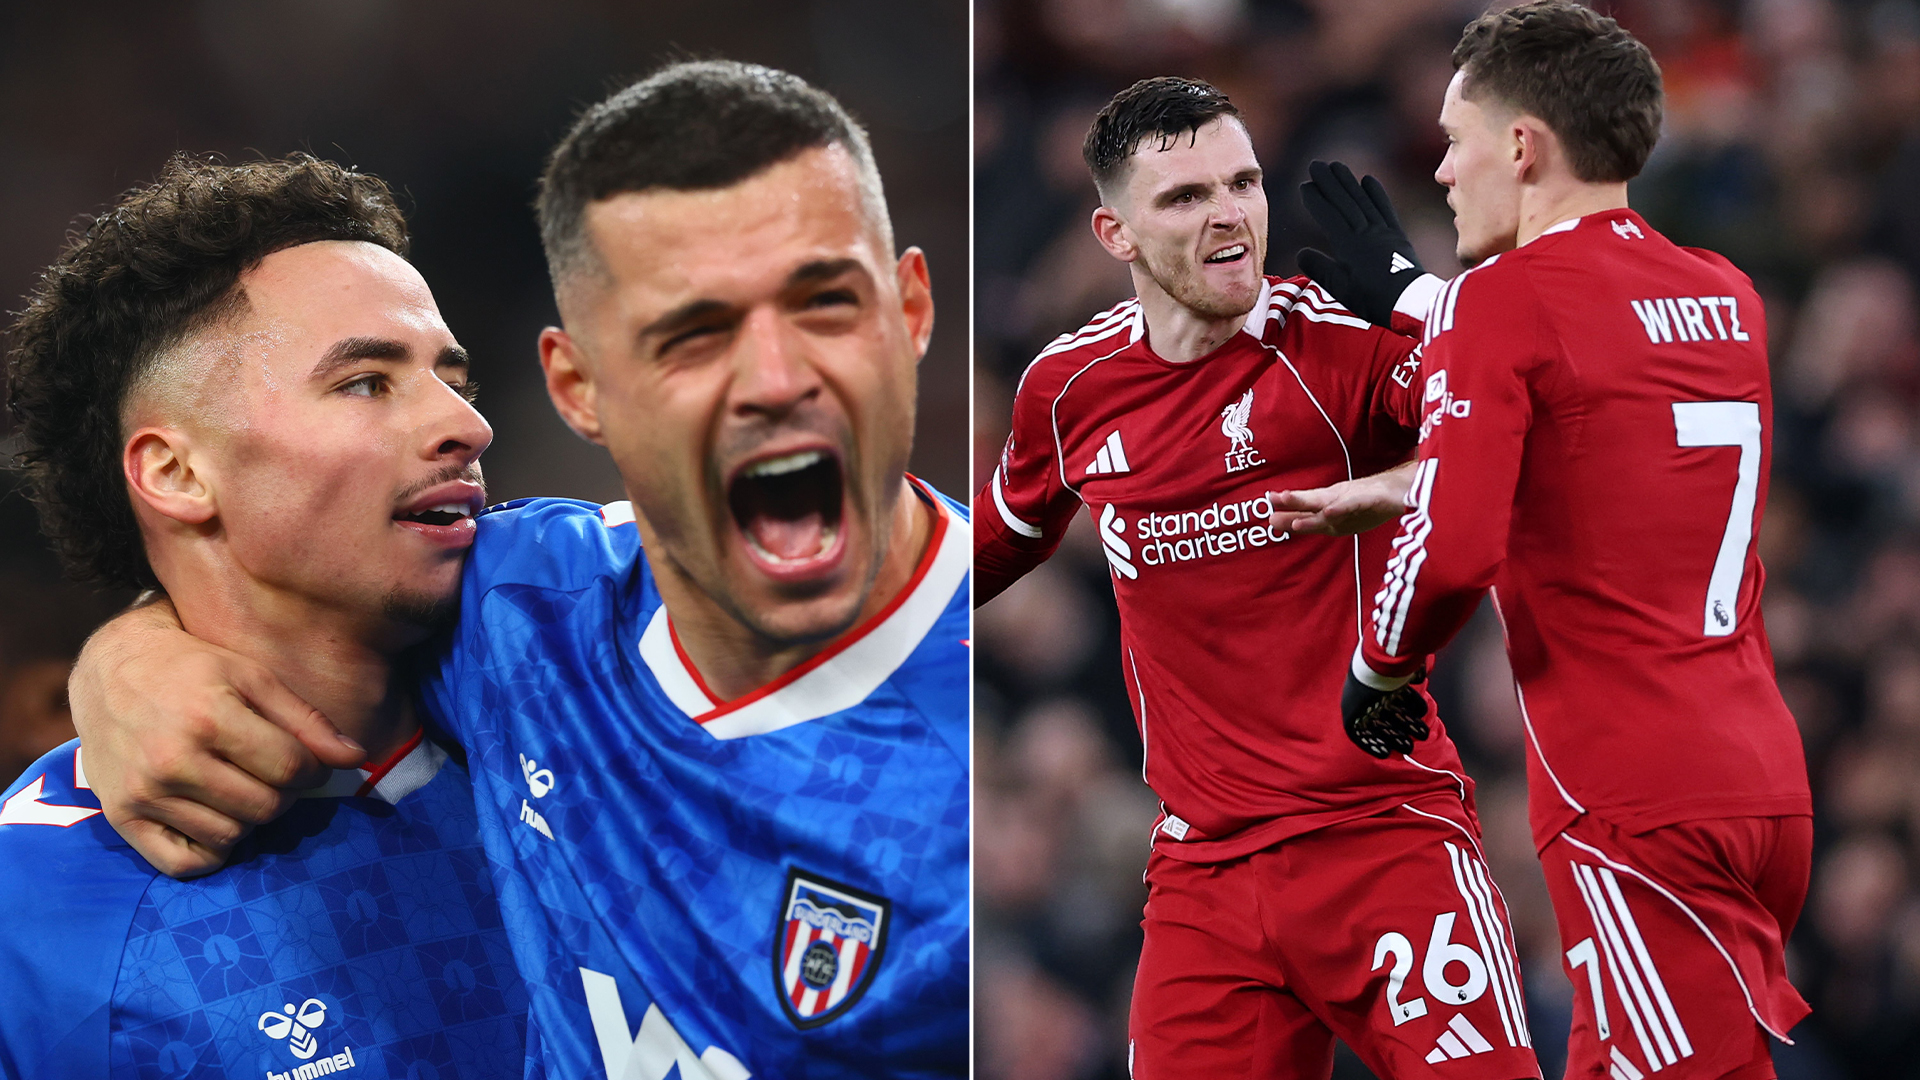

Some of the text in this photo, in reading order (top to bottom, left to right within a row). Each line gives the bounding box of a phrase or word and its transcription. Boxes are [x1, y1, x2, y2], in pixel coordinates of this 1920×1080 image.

[1631, 296, 1750, 344] WIRTZ
[1224, 450, 1267, 473] L.F.C.
[1137, 491, 1275, 540] standard
[1671, 401, 1762, 637] 7
[793, 904, 871, 943] SUNDERLAND
[1371, 911, 1489, 1027] 26
[1565, 936, 1612, 1041] 7
